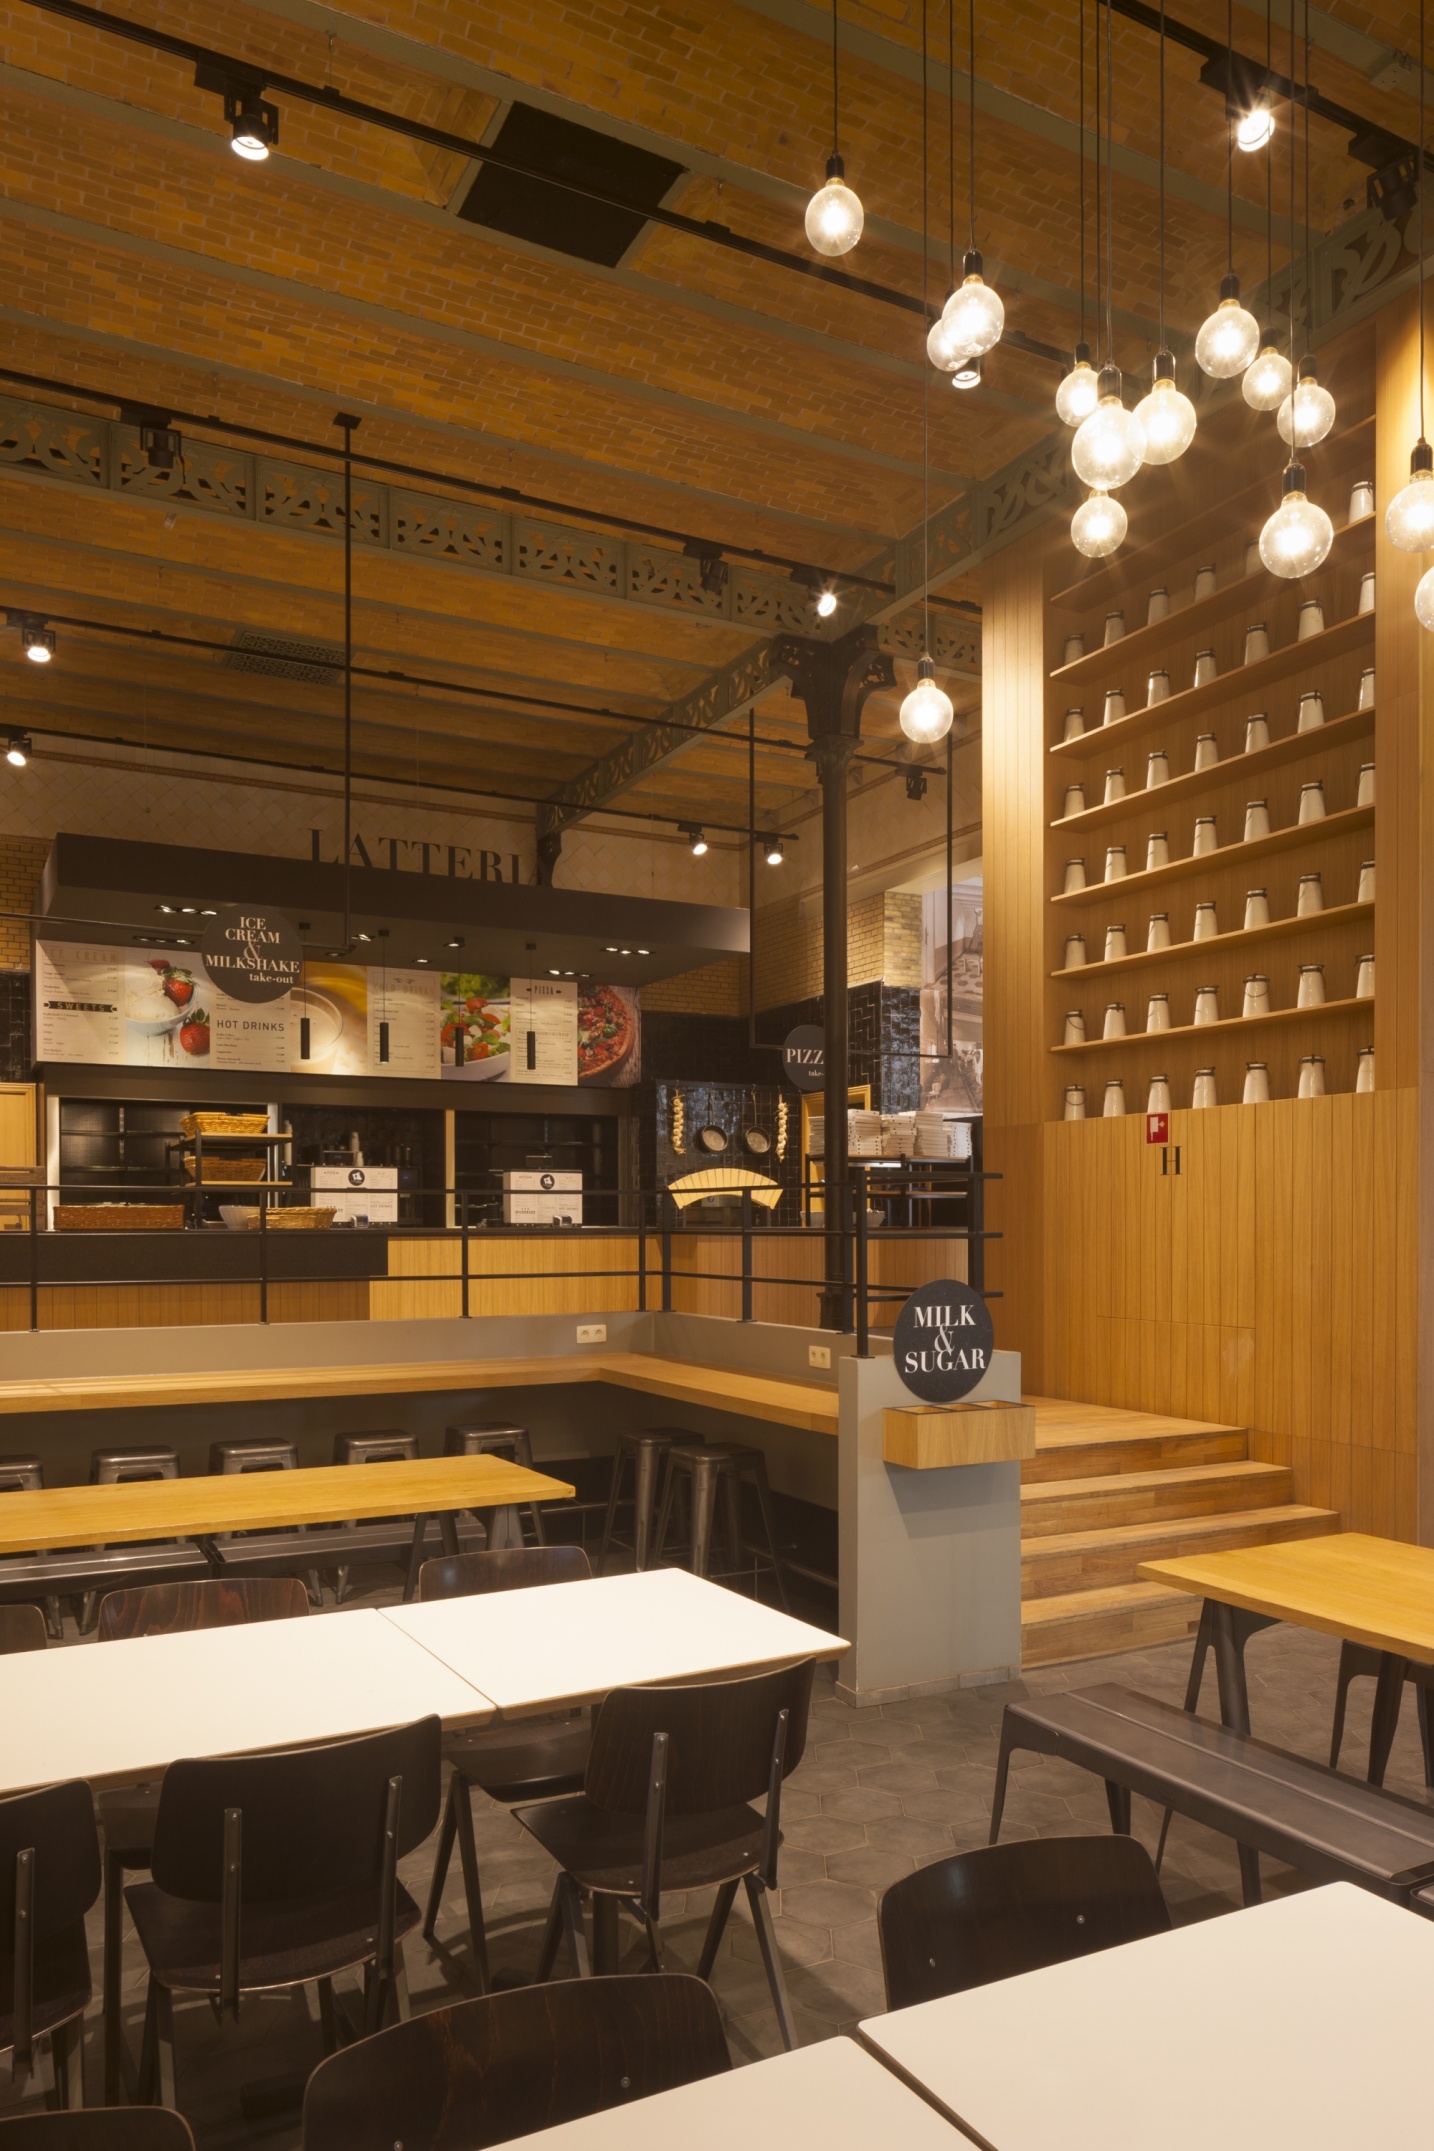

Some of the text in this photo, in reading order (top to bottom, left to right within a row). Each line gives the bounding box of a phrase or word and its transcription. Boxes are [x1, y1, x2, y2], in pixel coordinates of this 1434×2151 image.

[240, 916, 266, 930] ICE
[225, 928, 280, 944] CREAM
[243, 939, 262, 961] &
[206, 954, 300, 973] MILKSHAKE
[249, 972, 294, 984] take-out
[534, 985, 554, 995] PIZZA
[57, 1002, 105, 1012] SWEETS
[216, 1019, 284, 1032] HOT DRINKS
[786, 1048, 824, 1065] PIZZ
[808, 1069, 825, 1077] take-
[1160, 1145, 1183, 1176] H
[913, 1304, 976, 1328] MILK
[934, 1323, 955, 1357] &
[904, 1348, 986, 1374] SUGAR
